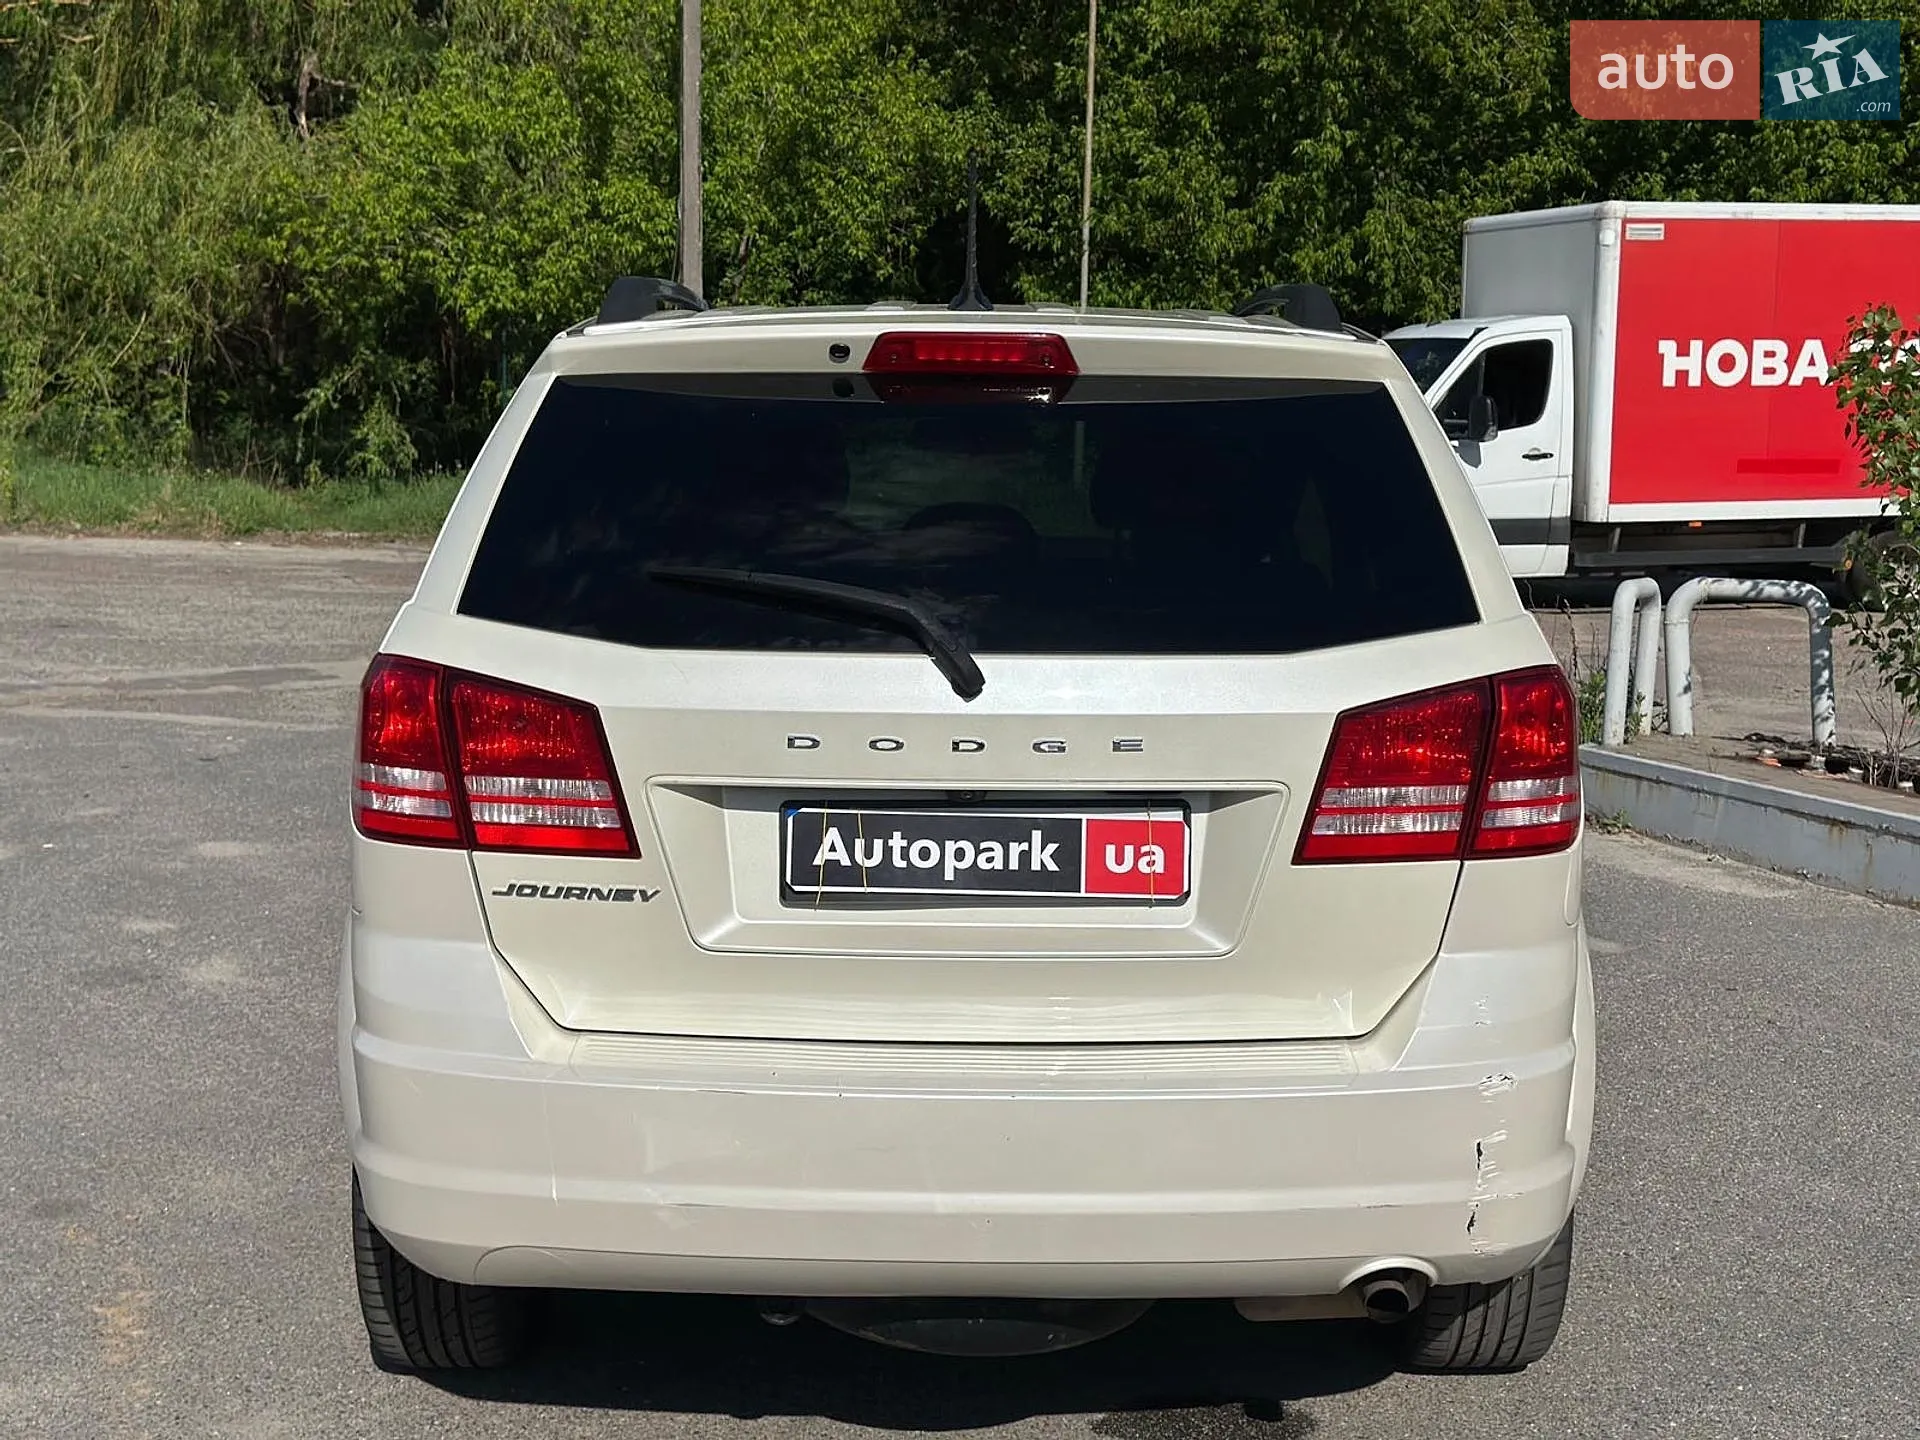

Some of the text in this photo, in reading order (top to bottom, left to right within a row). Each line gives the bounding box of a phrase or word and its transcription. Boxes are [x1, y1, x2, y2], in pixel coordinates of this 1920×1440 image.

[1658, 338, 1834, 388] НОВА
[787, 735, 1144, 754] DODGE
[812, 826, 1166, 881] Autopark ua
[491, 882, 662, 903] JOURNEY
